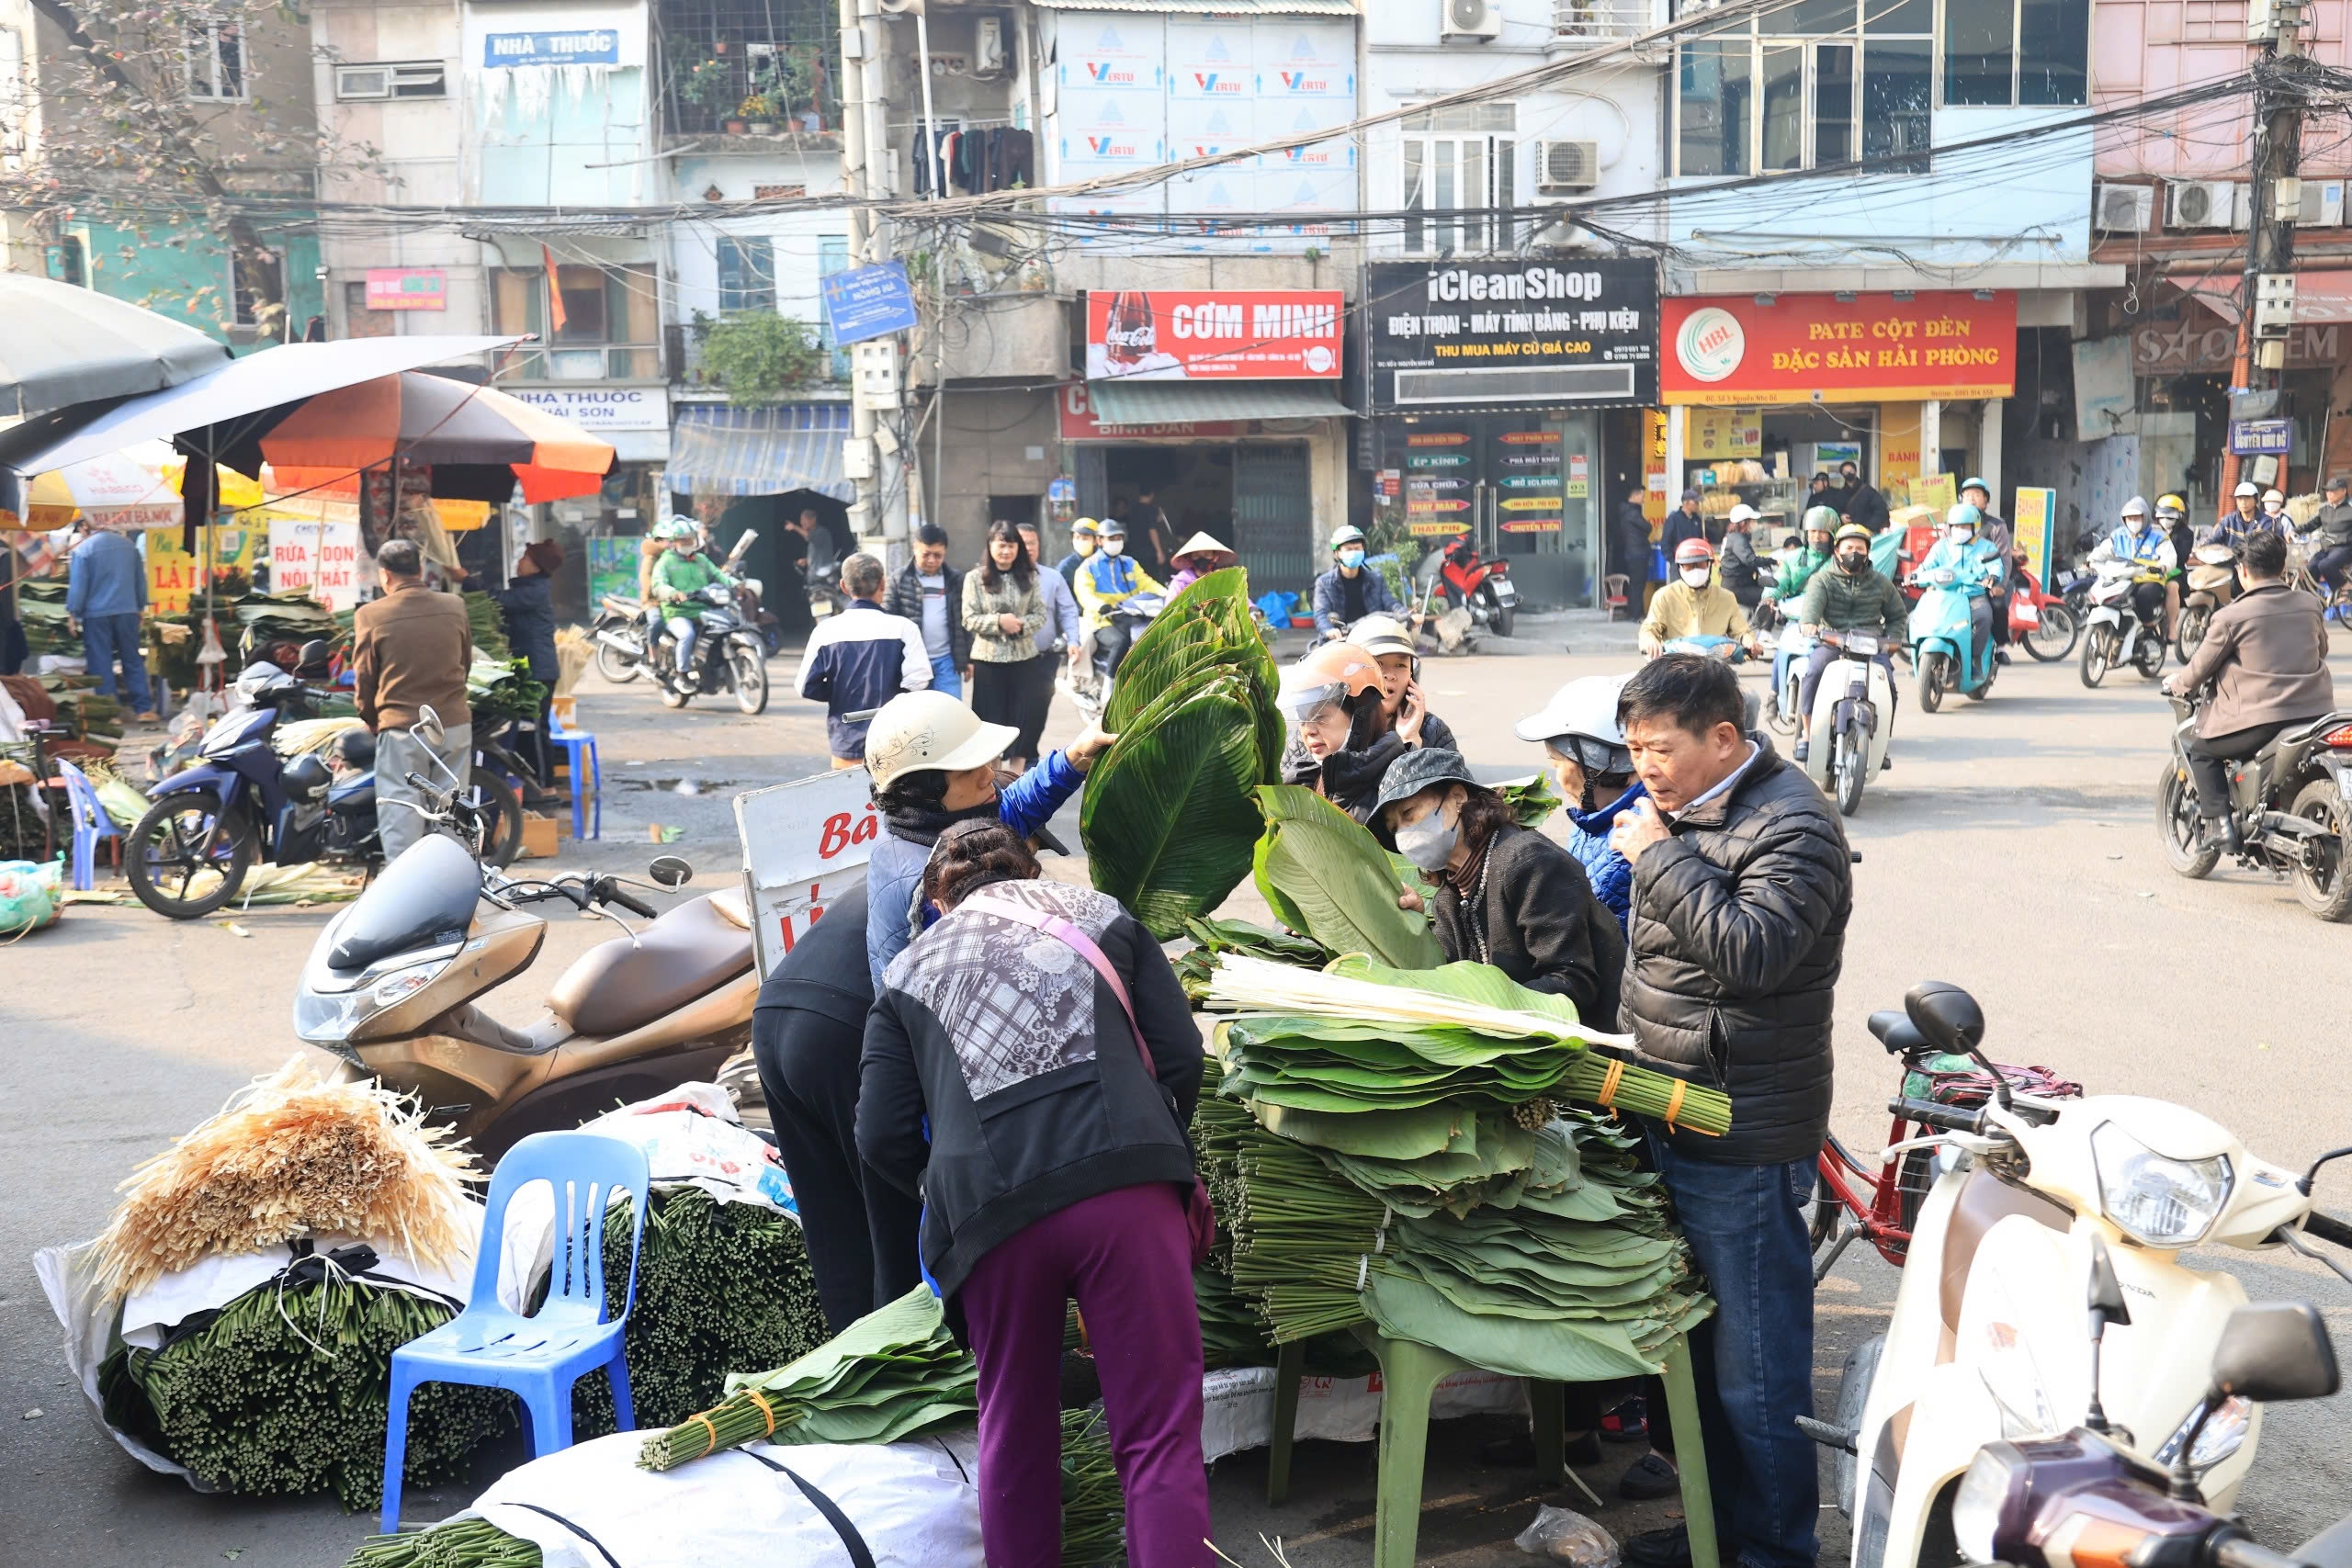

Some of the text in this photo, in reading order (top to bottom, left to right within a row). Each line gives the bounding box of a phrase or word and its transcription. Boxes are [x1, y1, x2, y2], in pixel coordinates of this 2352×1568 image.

[493, 30, 611, 55] NHÀ THUỐC
[1428, 269, 1601, 300] iCleanShop
[1172, 301, 1335, 339] CƠM MINH
[1388, 312, 1420, 339] ĐIỆN
[1421, 314, 1460, 338] THOẠI
[1471, 310, 1500, 333] MÁY
[1502, 309, 1533, 333] TÍNH
[1534, 306, 1570, 332] BẢNG
[1580, 310, 1607, 334] PHỤ
[1609, 307, 1640, 333] KIỆN
[1809, 315, 1971, 342] PATE CỘT ĐÈN
[1434, 340, 1591, 356] THU MUA MÁY CŨ GIÁ CAO
[1698, 325, 1734, 354] HBL
[2285, 325, 2338, 359] EM
[1771, 343, 1999, 373] ĐẶC SẢN HẢI PHÒNG
[564, 389, 642, 403] THUỐC
[1431, 457, 1459, 466] KÍNH
[1442, 525, 1461, 533] PIN
[275, 540, 306, 562] RỬA
[154, 559, 183, 589] LÁ
[2117, 1280, 2156, 1300] ONDA
